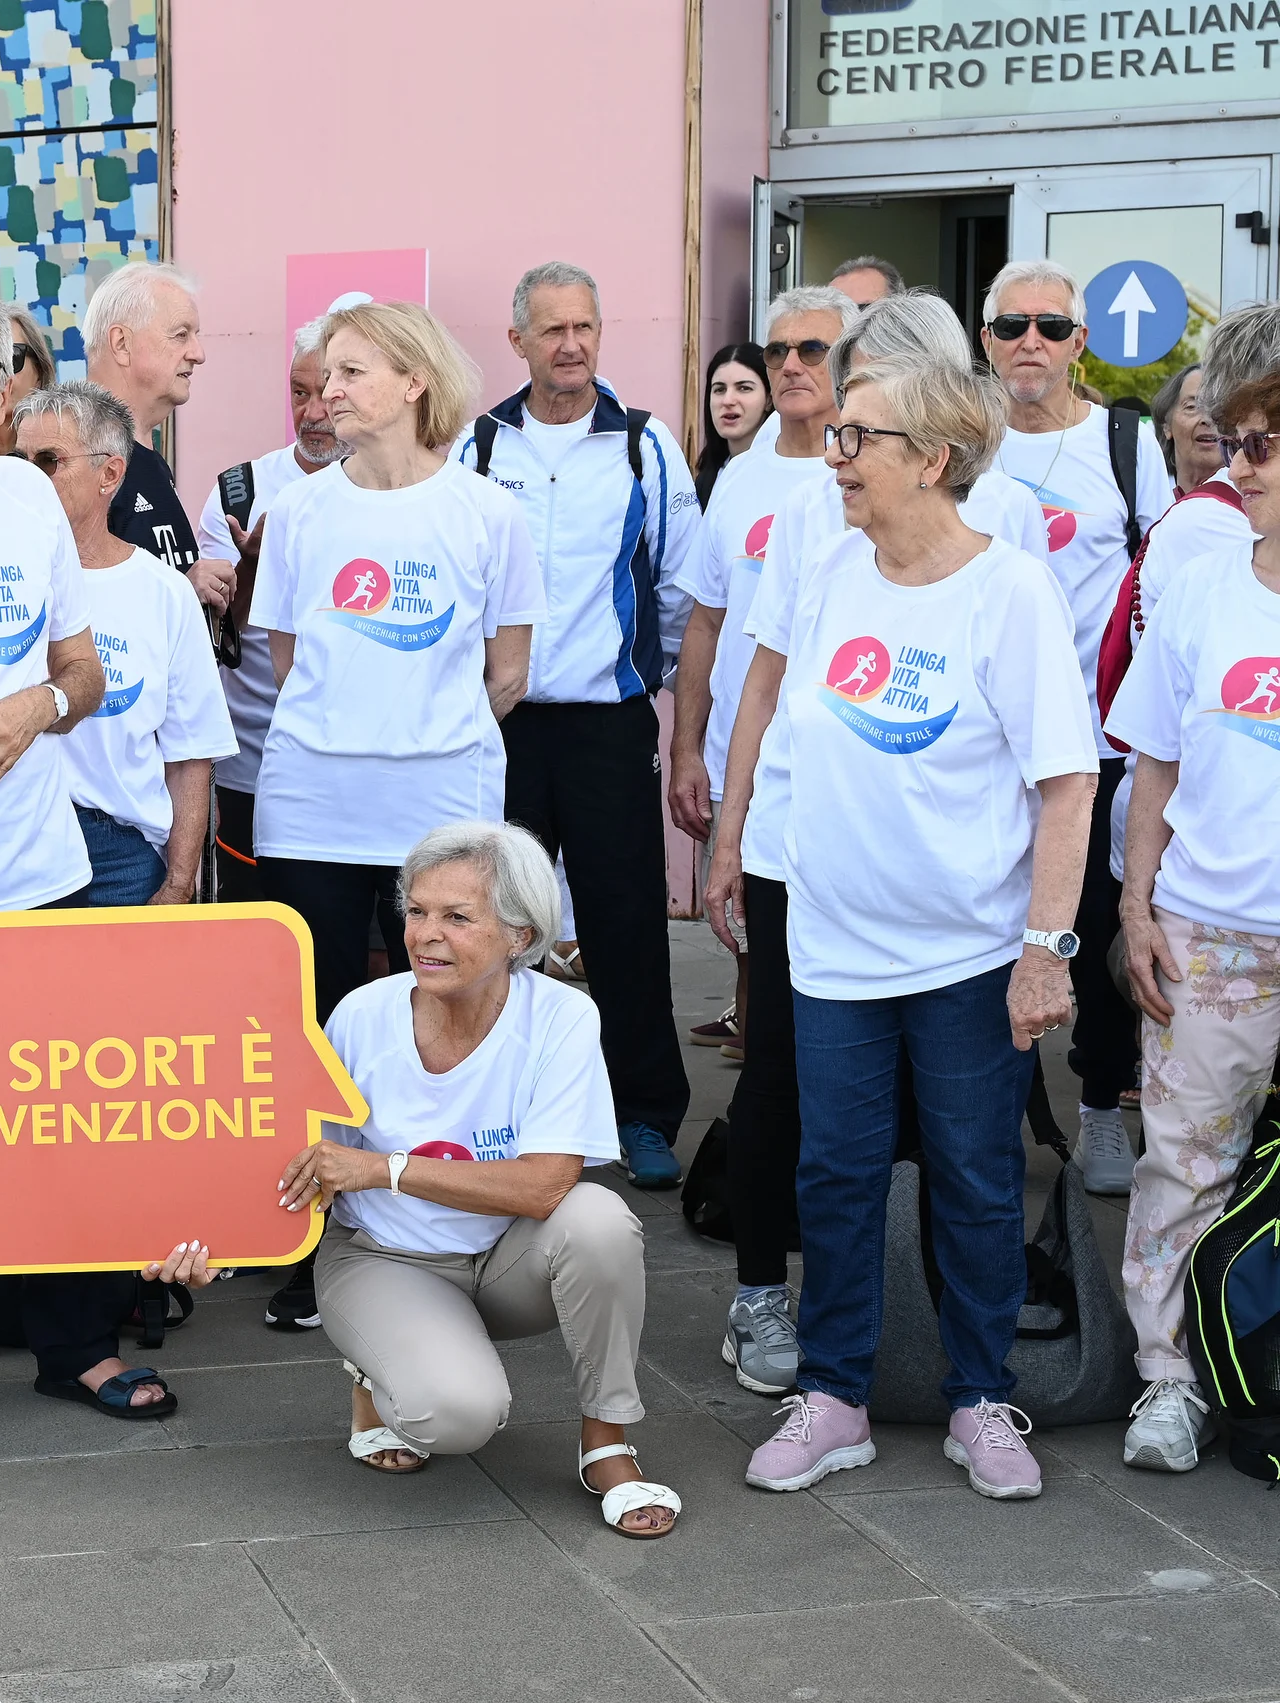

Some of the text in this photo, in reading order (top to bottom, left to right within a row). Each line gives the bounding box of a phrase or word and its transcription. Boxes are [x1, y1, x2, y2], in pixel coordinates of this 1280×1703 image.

[819, 0, 1280, 59] FEDERAZIONE ITALIANA
[817, 59, 986, 96] CENTRO
[1004, 42, 1235, 85] FEDERALE
[223, 464, 248, 507] Wils
[394, 559, 437, 581] LUNGA
[393, 578, 420, 596] VITA
[391, 596, 434, 615] ATTIVA
[7, 643, 22, 656] CON
[22, 629, 38, 650] STILE
[94, 632, 129, 655] UNGA
[353, 619, 442, 643] INVECCHIARE CON STILE
[897, 645, 947, 675] LUNGA
[891, 666, 921, 690] VITA
[109, 695, 130, 709] STILE
[881, 686, 929, 715] ATTIVA
[838, 706, 934, 744] INVECCHIARE CON STILE
[7, 1034, 216, 1092] SPORT
[240, 1016, 274, 1084] È
[472, 1124, 516, 1148] LUNGA
